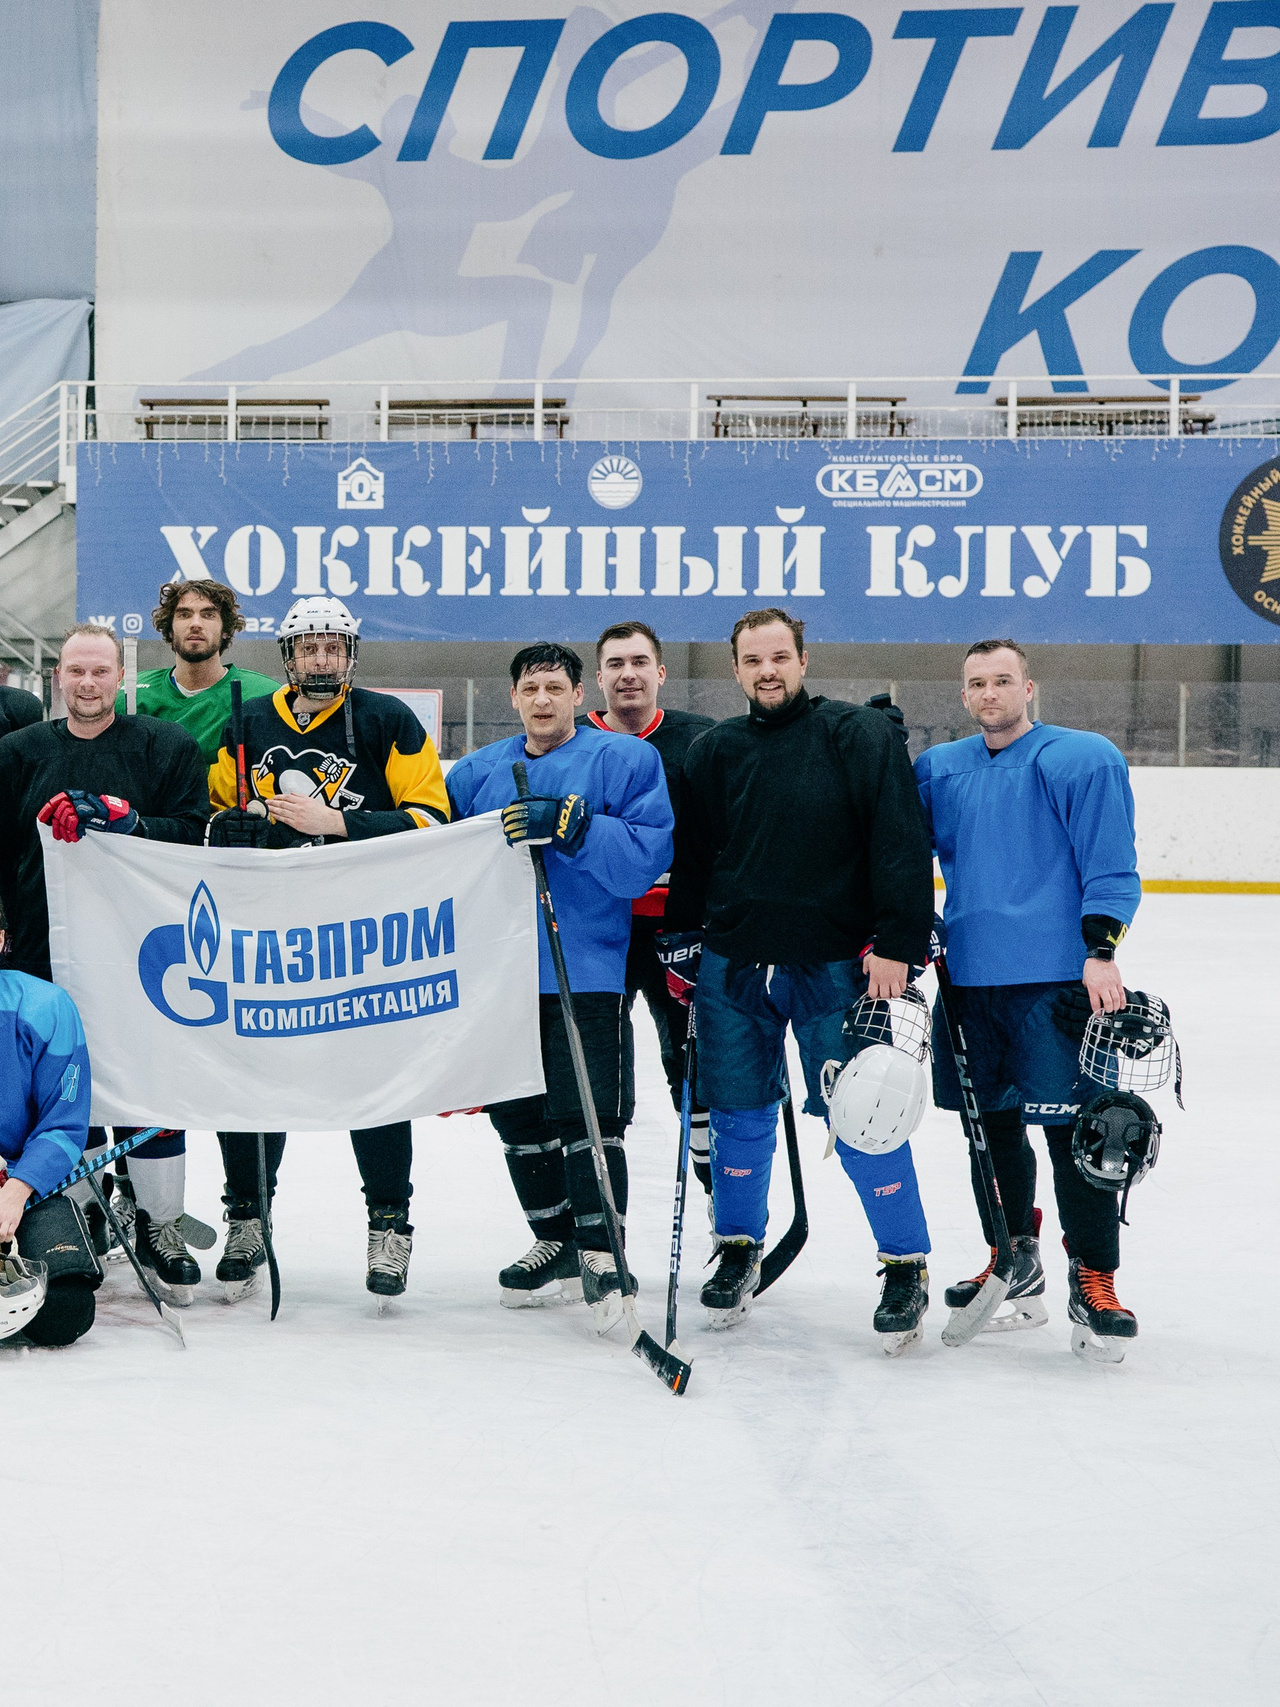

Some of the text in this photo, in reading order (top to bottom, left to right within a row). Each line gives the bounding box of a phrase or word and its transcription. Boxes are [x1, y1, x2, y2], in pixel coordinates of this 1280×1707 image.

[267, 0, 1280, 166] СПОРТИВ
[160, 506, 1153, 598] ХОККЕЙНЫЙ КЛУБ
[557, 794, 581, 839] STON
[231, 897, 455, 985] ГАЗПРОМ
[241, 978, 453, 1031] КОМПЛЕКТАЦИЯ
[1024, 1102, 1081, 1115] CCM
[723, 1166, 752, 1178] TSP
[874, 1181, 902, 1197] TSP
